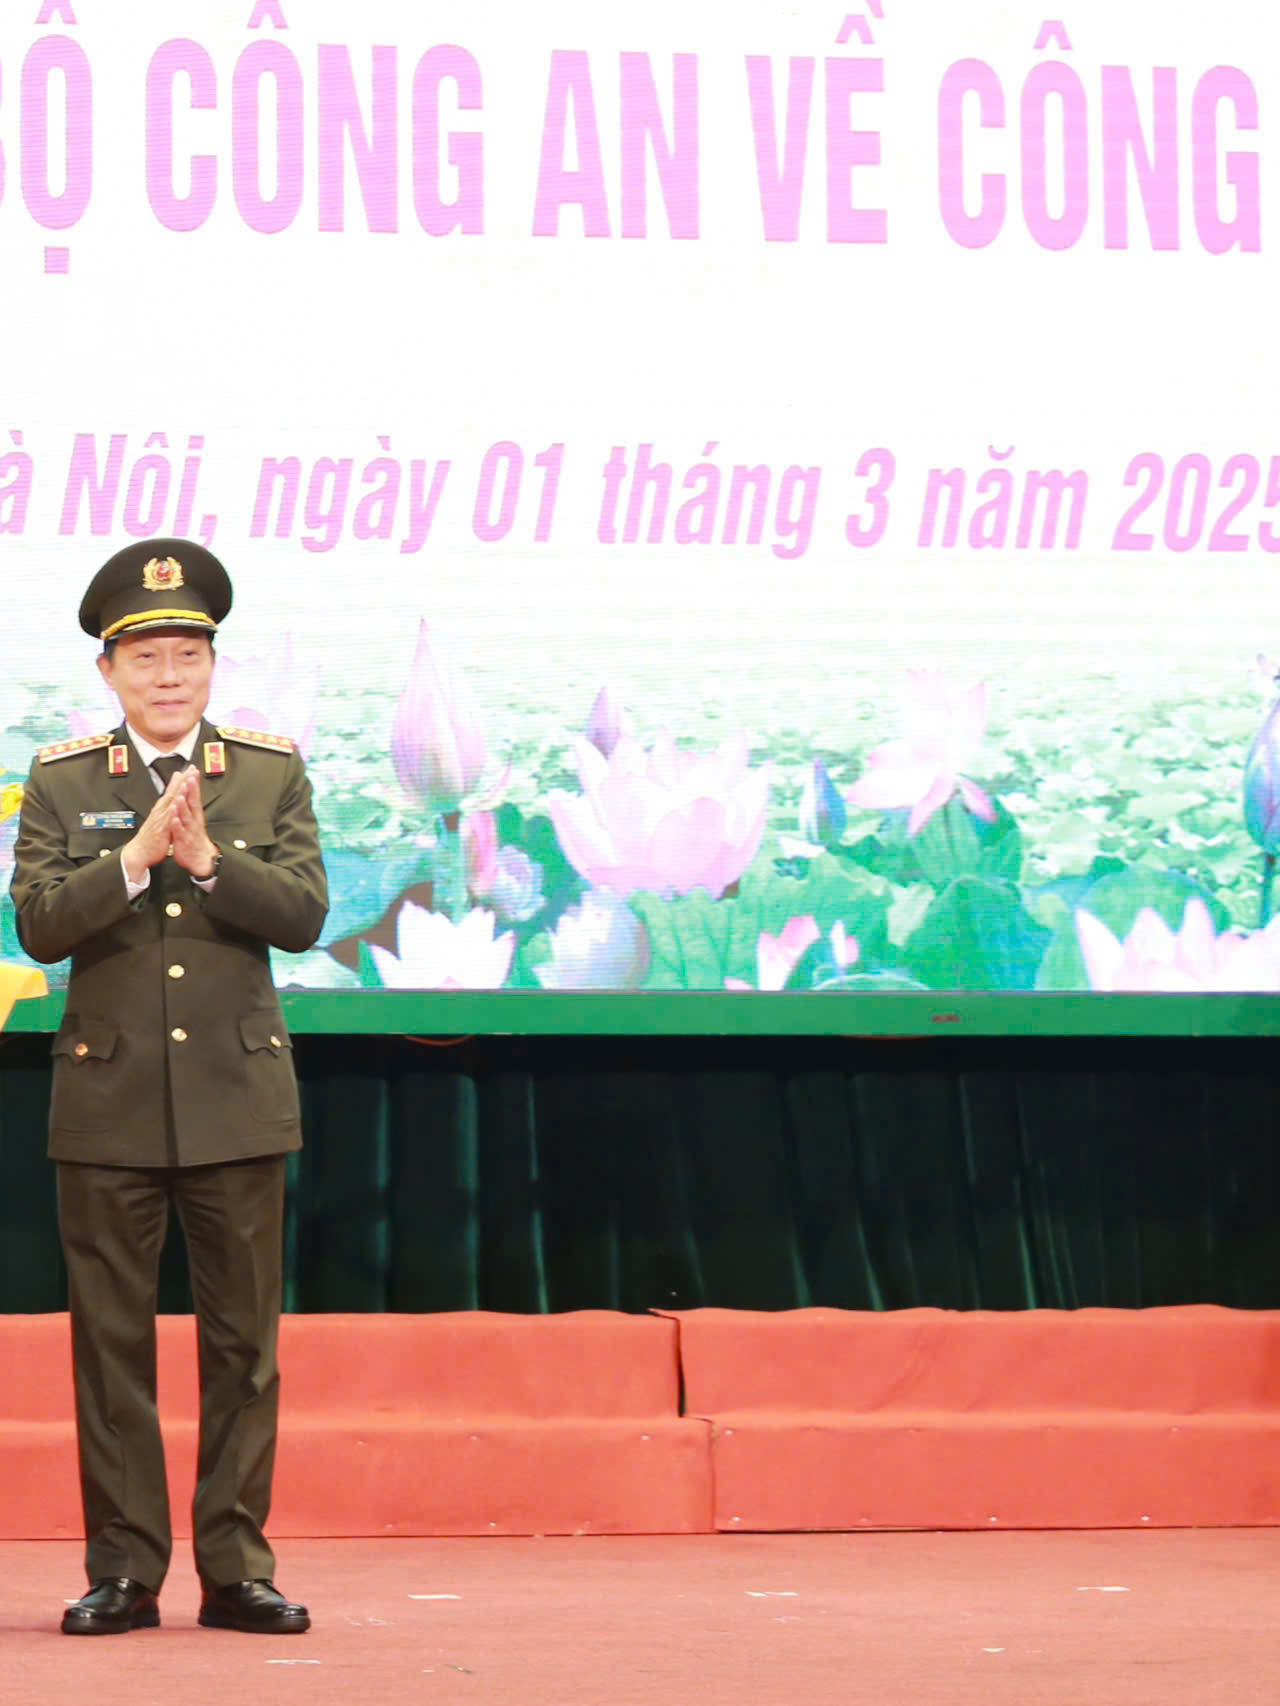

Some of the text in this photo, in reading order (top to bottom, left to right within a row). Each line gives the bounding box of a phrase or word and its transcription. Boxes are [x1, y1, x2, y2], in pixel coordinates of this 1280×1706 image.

[145, 0, 484, 237] CÔNG
[532, 49, 700, 240] AN
[744, 0, 888, 244] VỀ
[938, 20, 1261, 256] CÔNG
[249, 436, 451, 554] ngày
[472, 441, 564, 543] 01
[598, 441, 821, 560] tháng
[845, 447, 896, 548] 3
[917, 445, 1089, 550] năm
